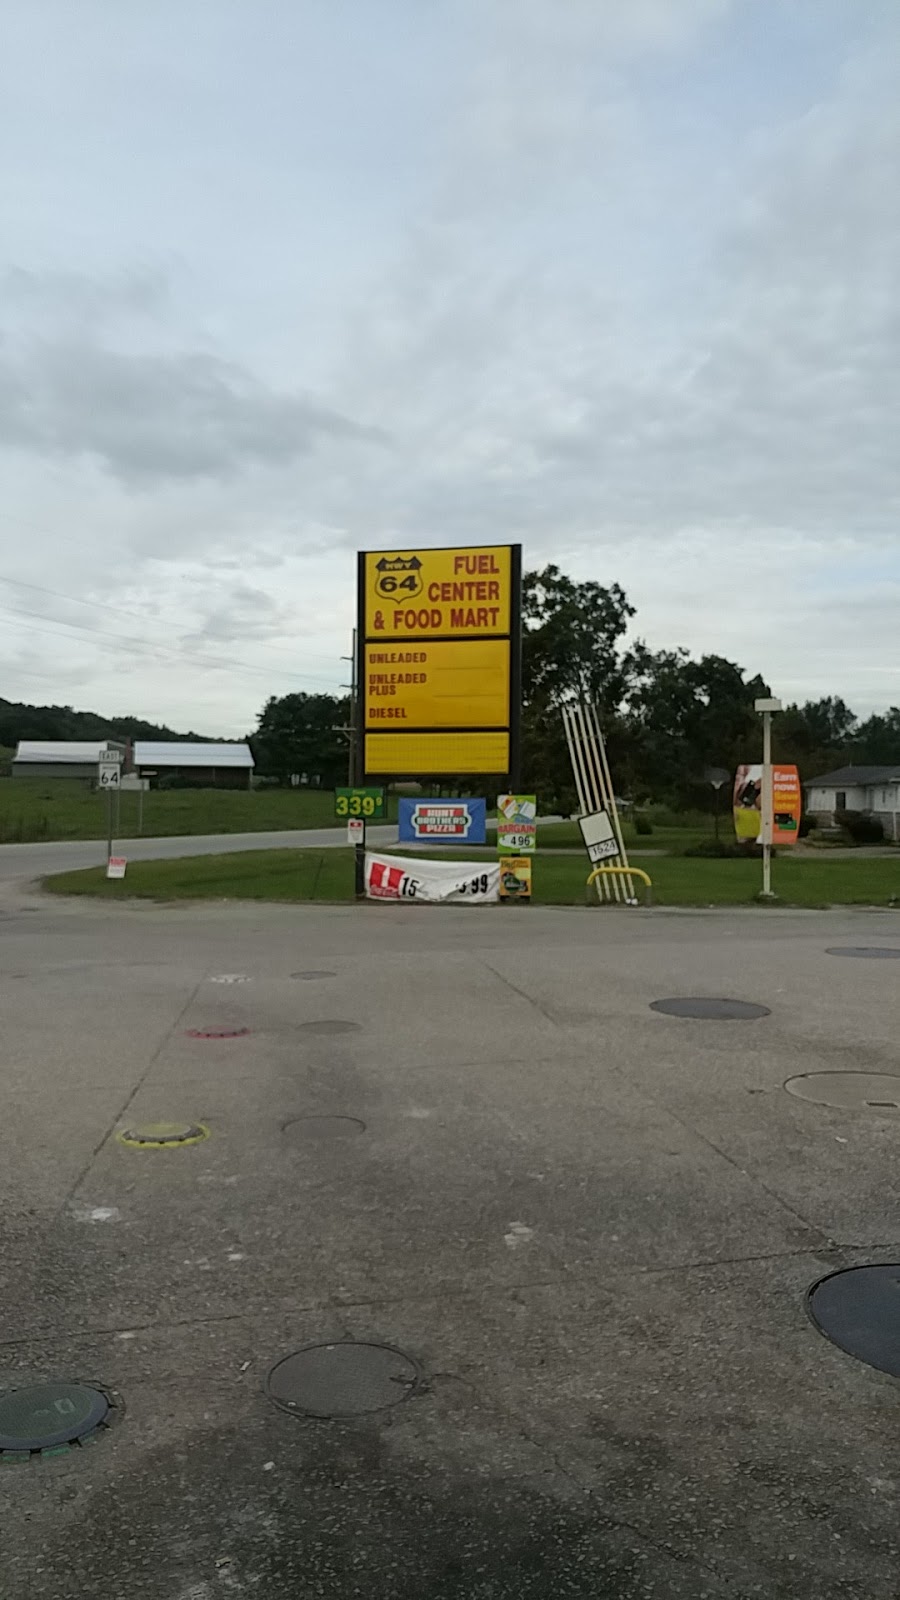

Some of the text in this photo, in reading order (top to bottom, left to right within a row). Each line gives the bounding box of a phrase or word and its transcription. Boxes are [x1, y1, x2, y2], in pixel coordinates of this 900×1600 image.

[385, 562, 412, 570] HWY
[454, 555, 500, 575] FUEL
[379, 575, 418, 592] 64
[428, 581, 500, 602] CENTER
[373, 607, 500, 630] & FOOD MART
[369, 652, 427, 664] UNLEADED
[369, 673, 427, 684] UNLEADED
[369, 685, 396, 696] PLUS
[369, 707, 408, 719] DIESEL
[101, 772, 119, 785] 64
[773, 772, 797, 781] Earn
[427, 809, 455, 817] HUNT
[416, 817, 467, 825] BROTHERS
[426, 824, 457, 833] PIZZA
[497, 824, 536, 834] BARGAIN
[593, 841, 616, 856] 1524
[401, 877, 420, 896] 15
